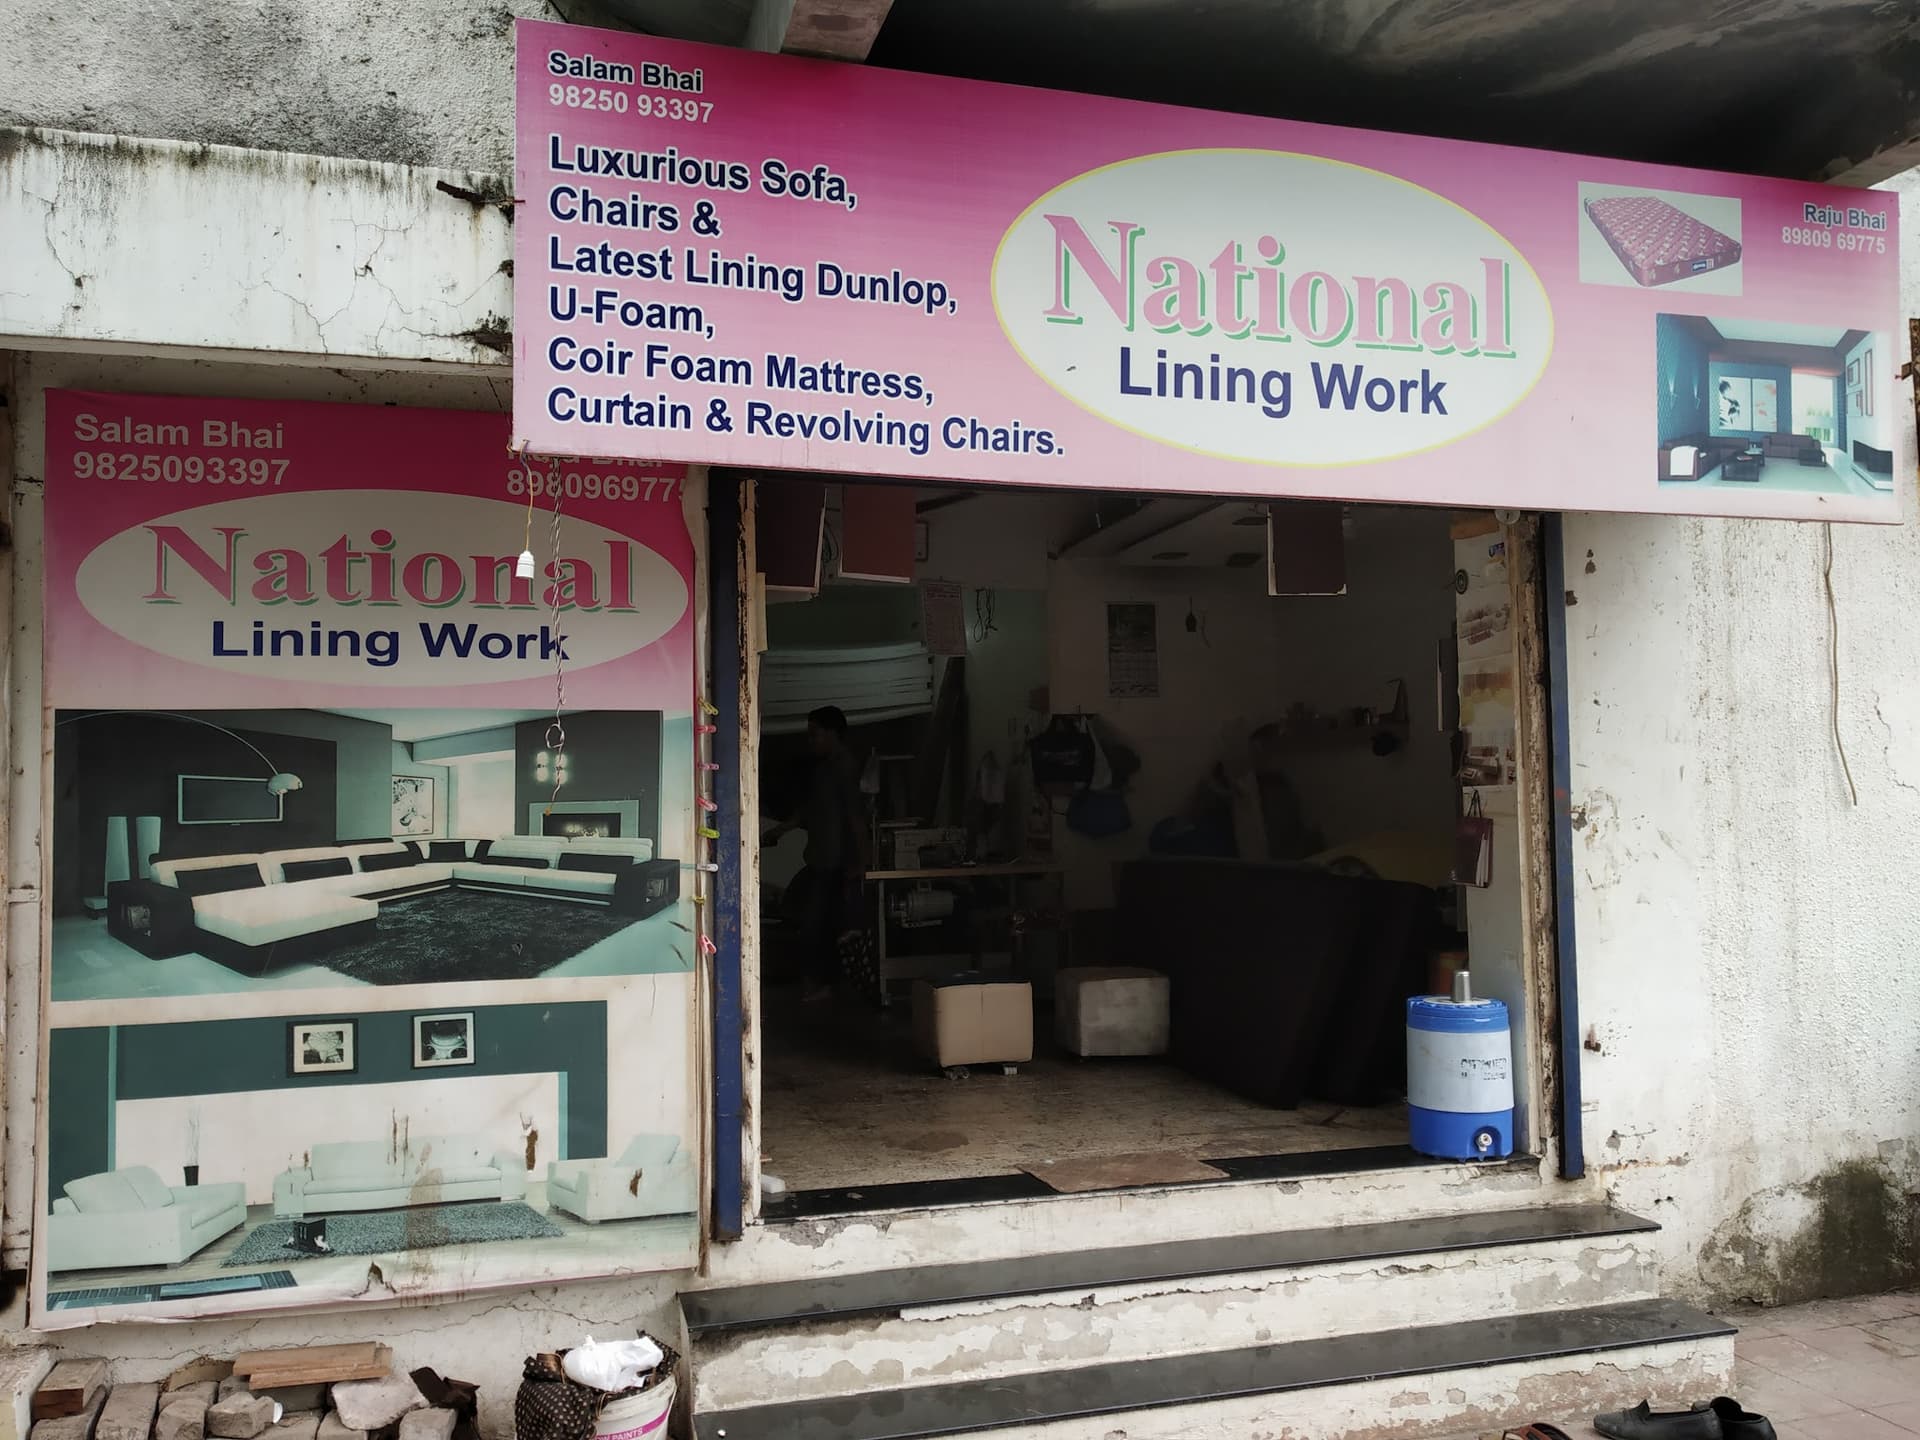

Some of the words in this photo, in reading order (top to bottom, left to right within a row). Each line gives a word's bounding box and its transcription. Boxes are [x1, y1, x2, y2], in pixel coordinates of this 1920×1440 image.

[549, 52, 633, 84] Salam
[642, 63, 702, 92] Bhai
[549, 84, 628, 114] 98250
[637, 94, 714, 124] 93397
[550, 135, 749, 190] Luxurious
[762, 160, 857, 209] Sofa,
[549, 186, 679, 234] Chairs
[693, 201, 721, 236] &
[1804, 203, 1842, 228] Raju
[1847, 208, 1887, 231] Bhai
[1782, 226, 1832, 250] 89809
[1836, 233, 1886, 254] 69775
[550, 236, 673, 281] Latest
[686, 248, 803, 301] Lining
[817, 263, 957, 314] Dunlop,
[1042, 213, 1517, 359] National
[549, 286, 715, 339] U-Foam,
[549, 337, 633, 376] Coir
[646, 345, 752, 386] Foam
[766, 355, 933, 404] Mattress,
[1119, 346, 1292, 419] Lining
[1310, 361, 1448, 416] Work
[74, 413, 189, 450] Salam
[203, 418, 285, 450] Bhai
[548, 386, 692, 431] Curtain
[706, 398, 733, 433] &
[746, 402, 930, 456] Revolving
[942, 417, 1065, 456] Chairs.
[72, 452, 290, 486] 9825093397
[142, 523, 640, 614] National
[212, 620, 400, 667] Lining
[418, 622, 571, 662] Work
